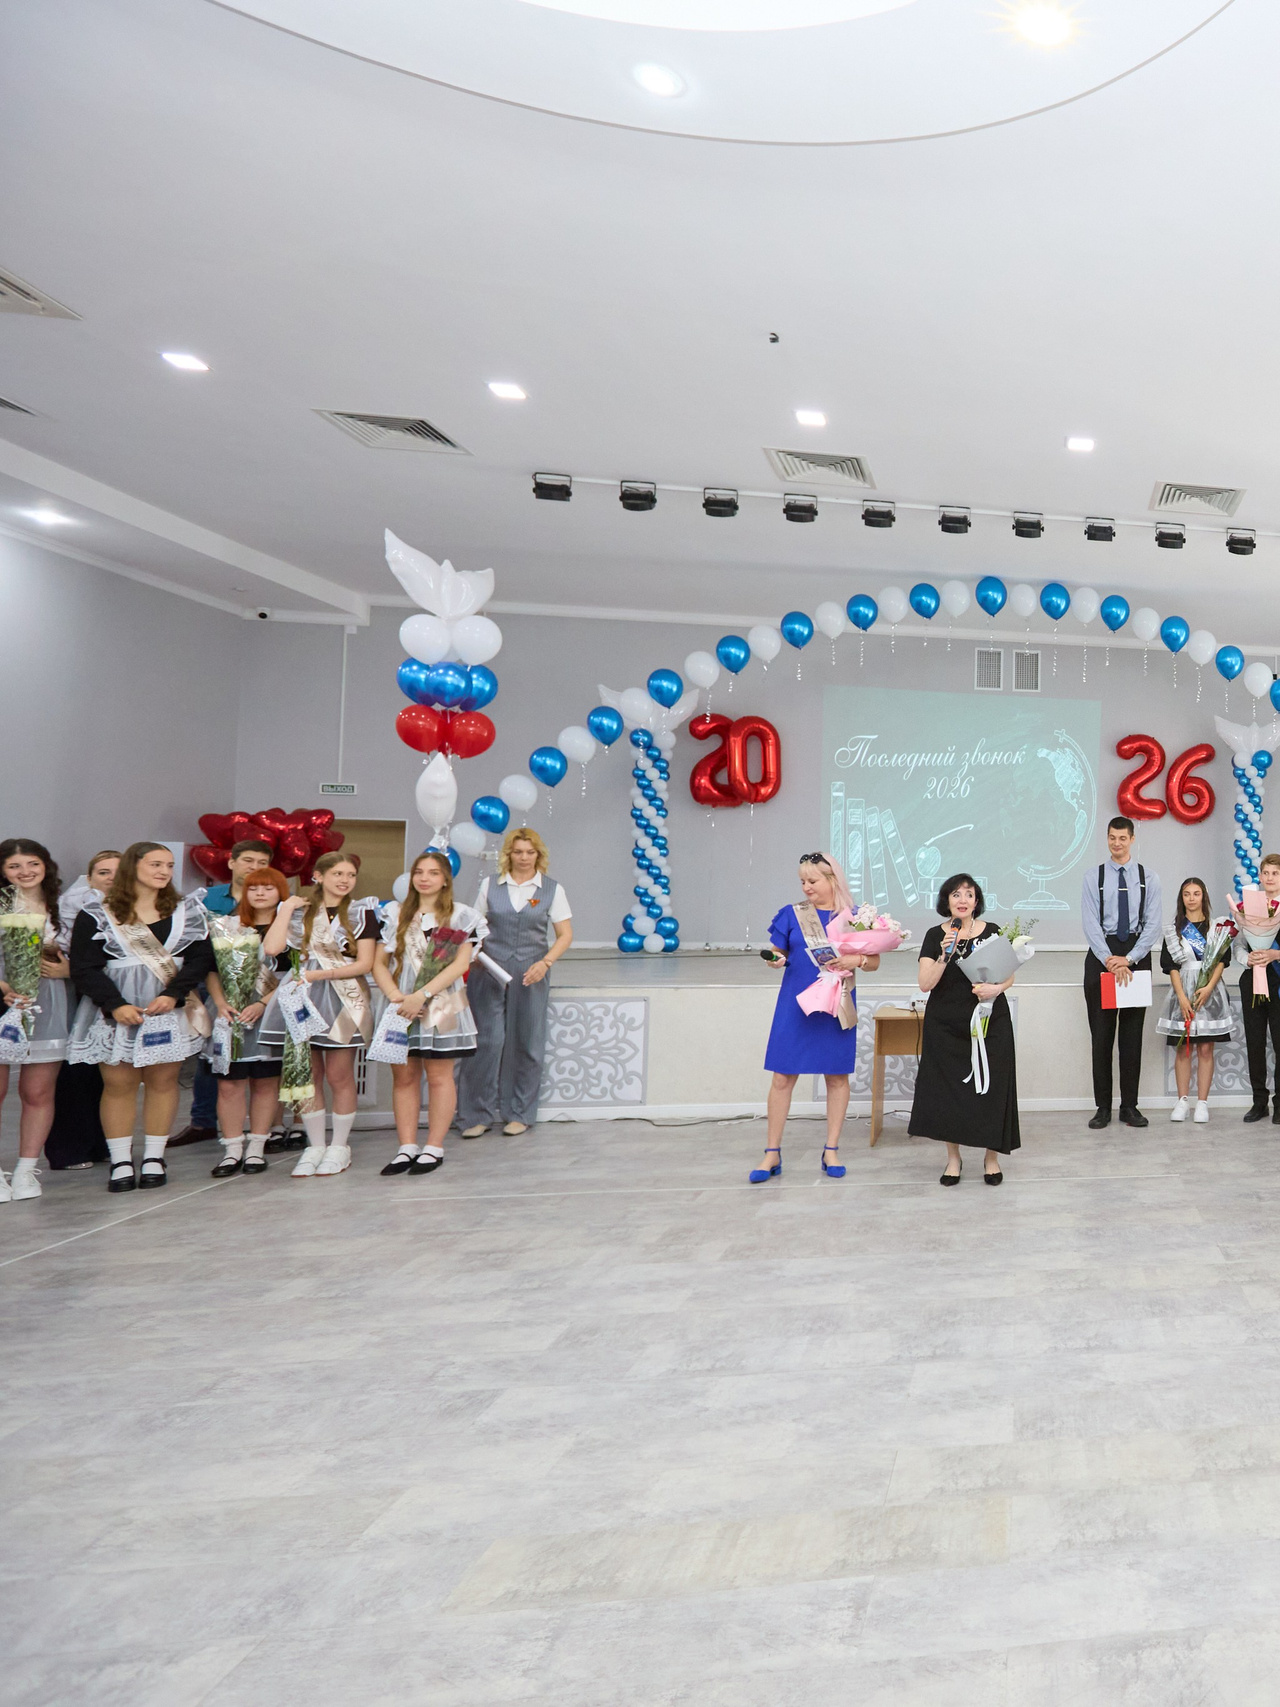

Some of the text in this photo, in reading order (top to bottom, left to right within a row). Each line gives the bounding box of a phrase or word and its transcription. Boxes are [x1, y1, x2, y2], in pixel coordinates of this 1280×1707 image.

[689, 713, 782, 808] 20
[834, 735, 1027, 780] Последний звонок
[323, 785, 353, 793] ВЫХОД
[923, 775, 975, 799] 2026
[1116, 734, 1215, 826] 26
[342, 986, 365, 1010] 2026
